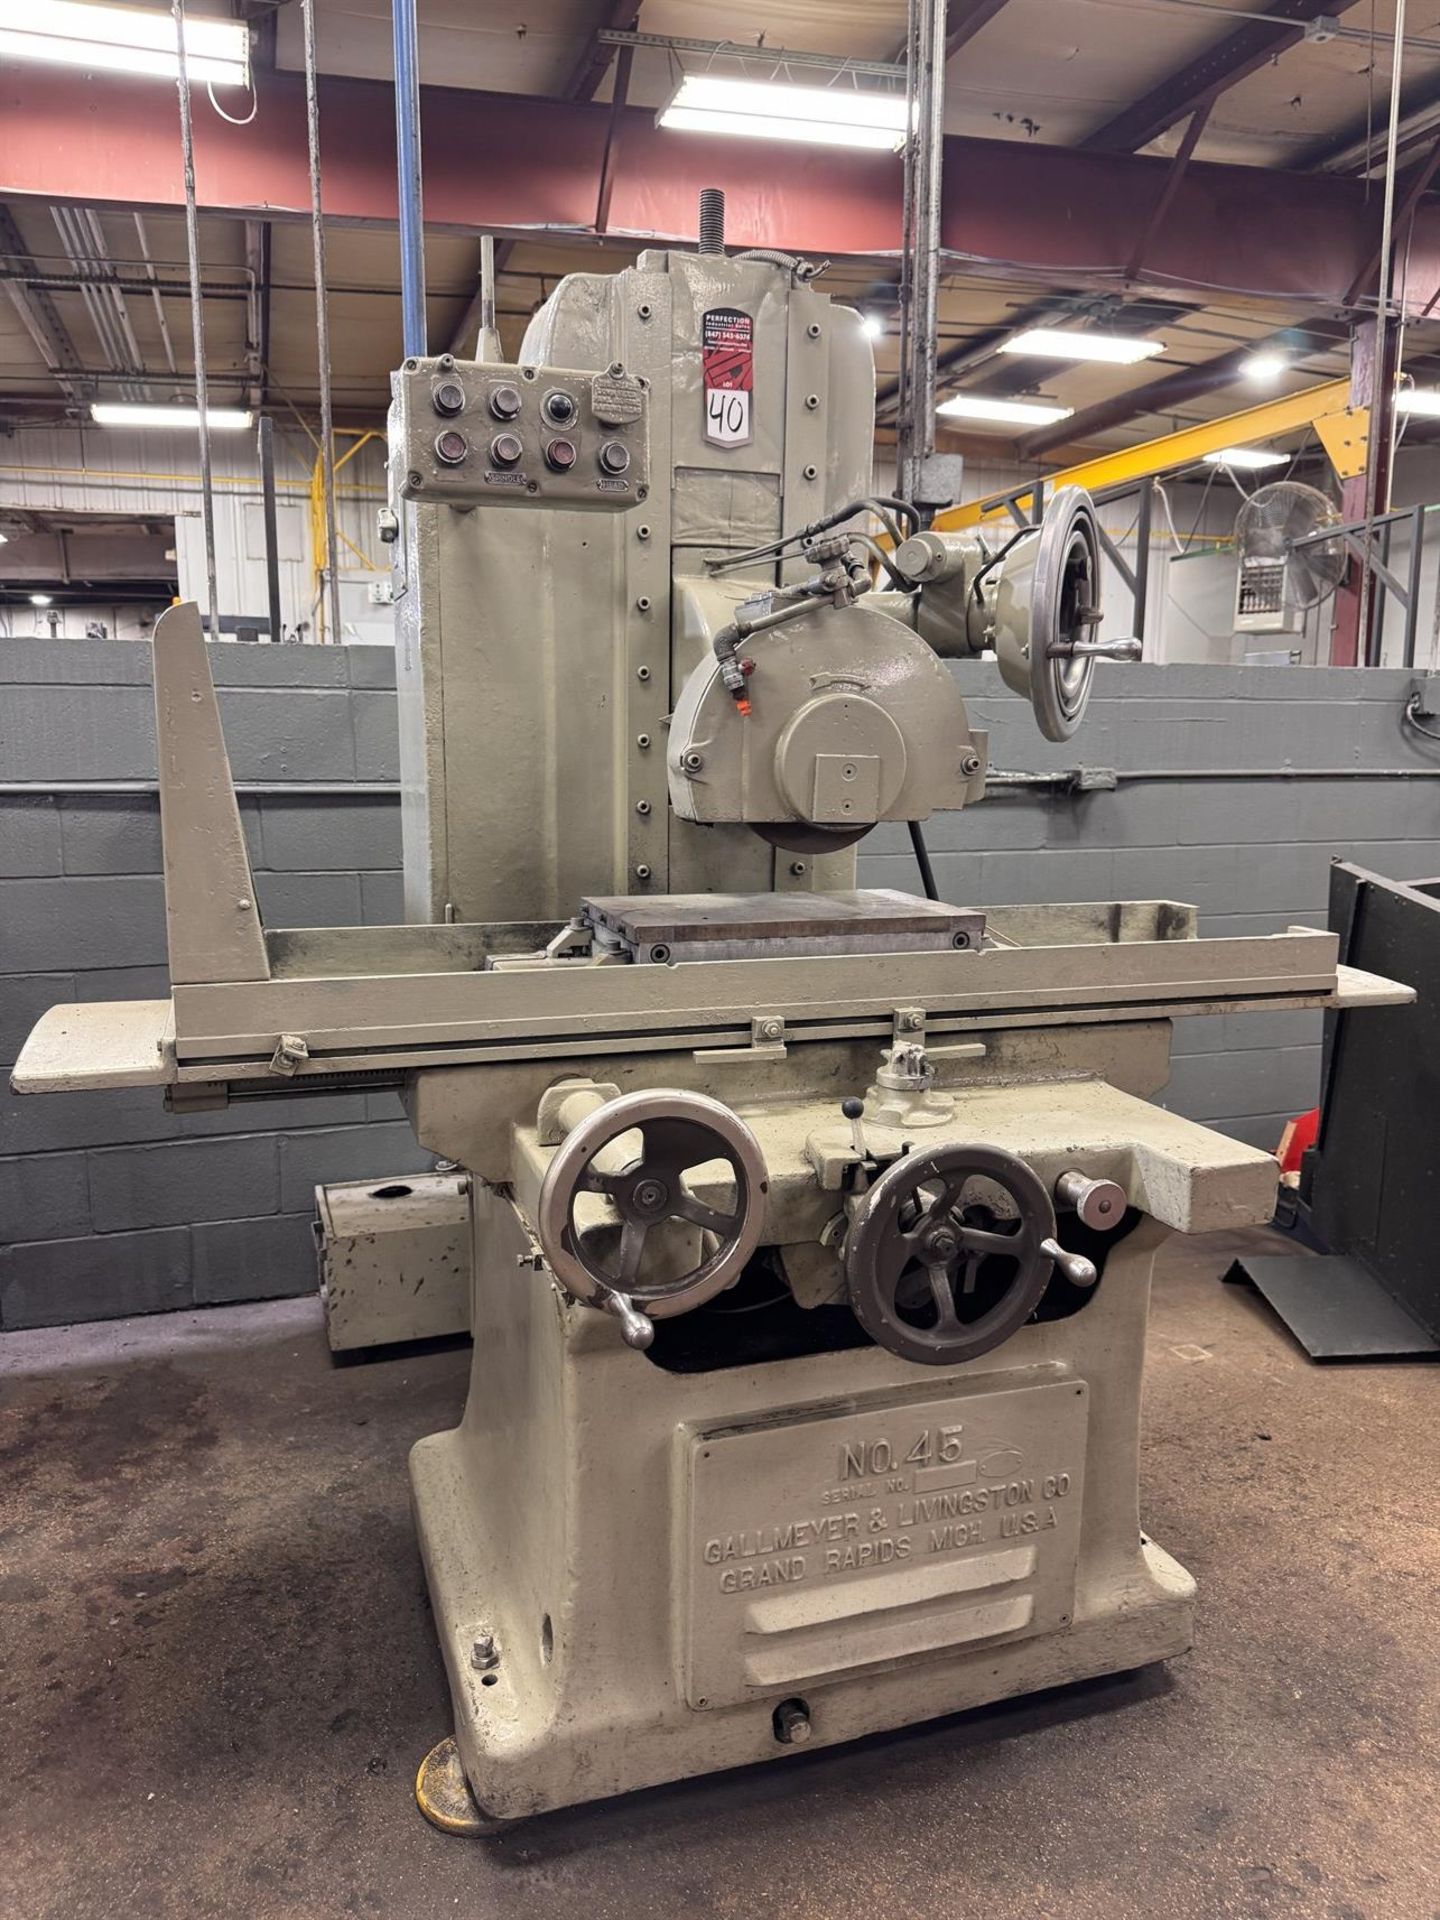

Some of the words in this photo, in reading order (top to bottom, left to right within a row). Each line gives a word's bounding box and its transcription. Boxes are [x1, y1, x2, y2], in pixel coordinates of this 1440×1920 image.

[706, 314, 750, 324] PERFECTION
[709, 393, 743, 433] 40
[840, 1437, 898, 1480] NO.
[906, 1425, 963, 1465] 45
[822, 1483, 877, 1505] SERIAL
[704, 1512, 860, 1564] GALLMEYER
[869, 1507, 888, 1533] &
[899, 1478, 1034, 1528] LIVINGSTON
[720, 1556, 806, 1593] GRAND
[825, 1536, 911, 1573] RAPIDS
